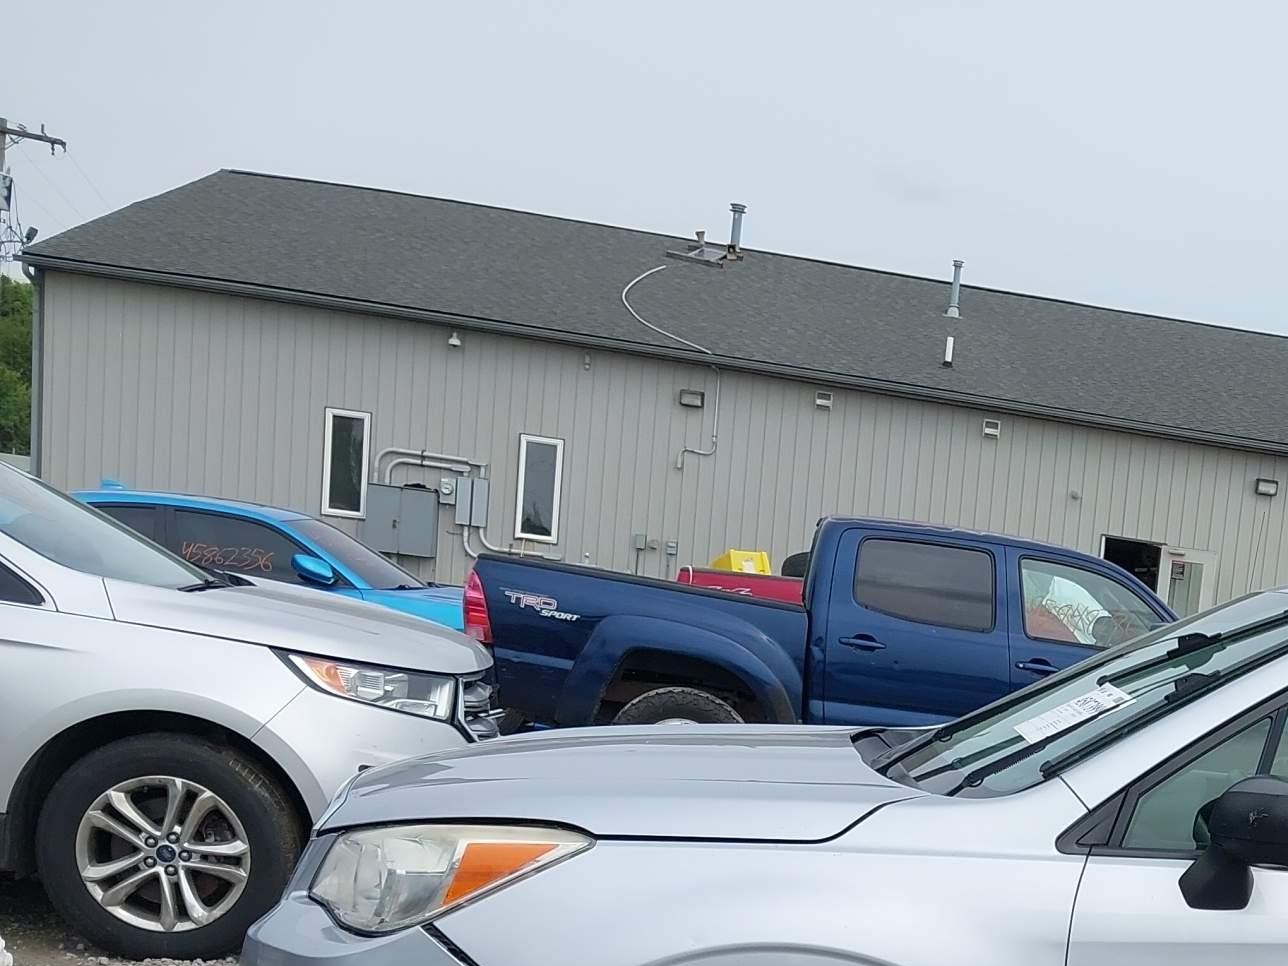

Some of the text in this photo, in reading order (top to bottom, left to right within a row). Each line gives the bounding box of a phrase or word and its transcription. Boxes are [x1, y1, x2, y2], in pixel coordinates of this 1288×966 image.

[182, 542, 274, 572] 45862356
[504, 590, 558, 611] TRD
[540, 609, 580, 621] SPORT
